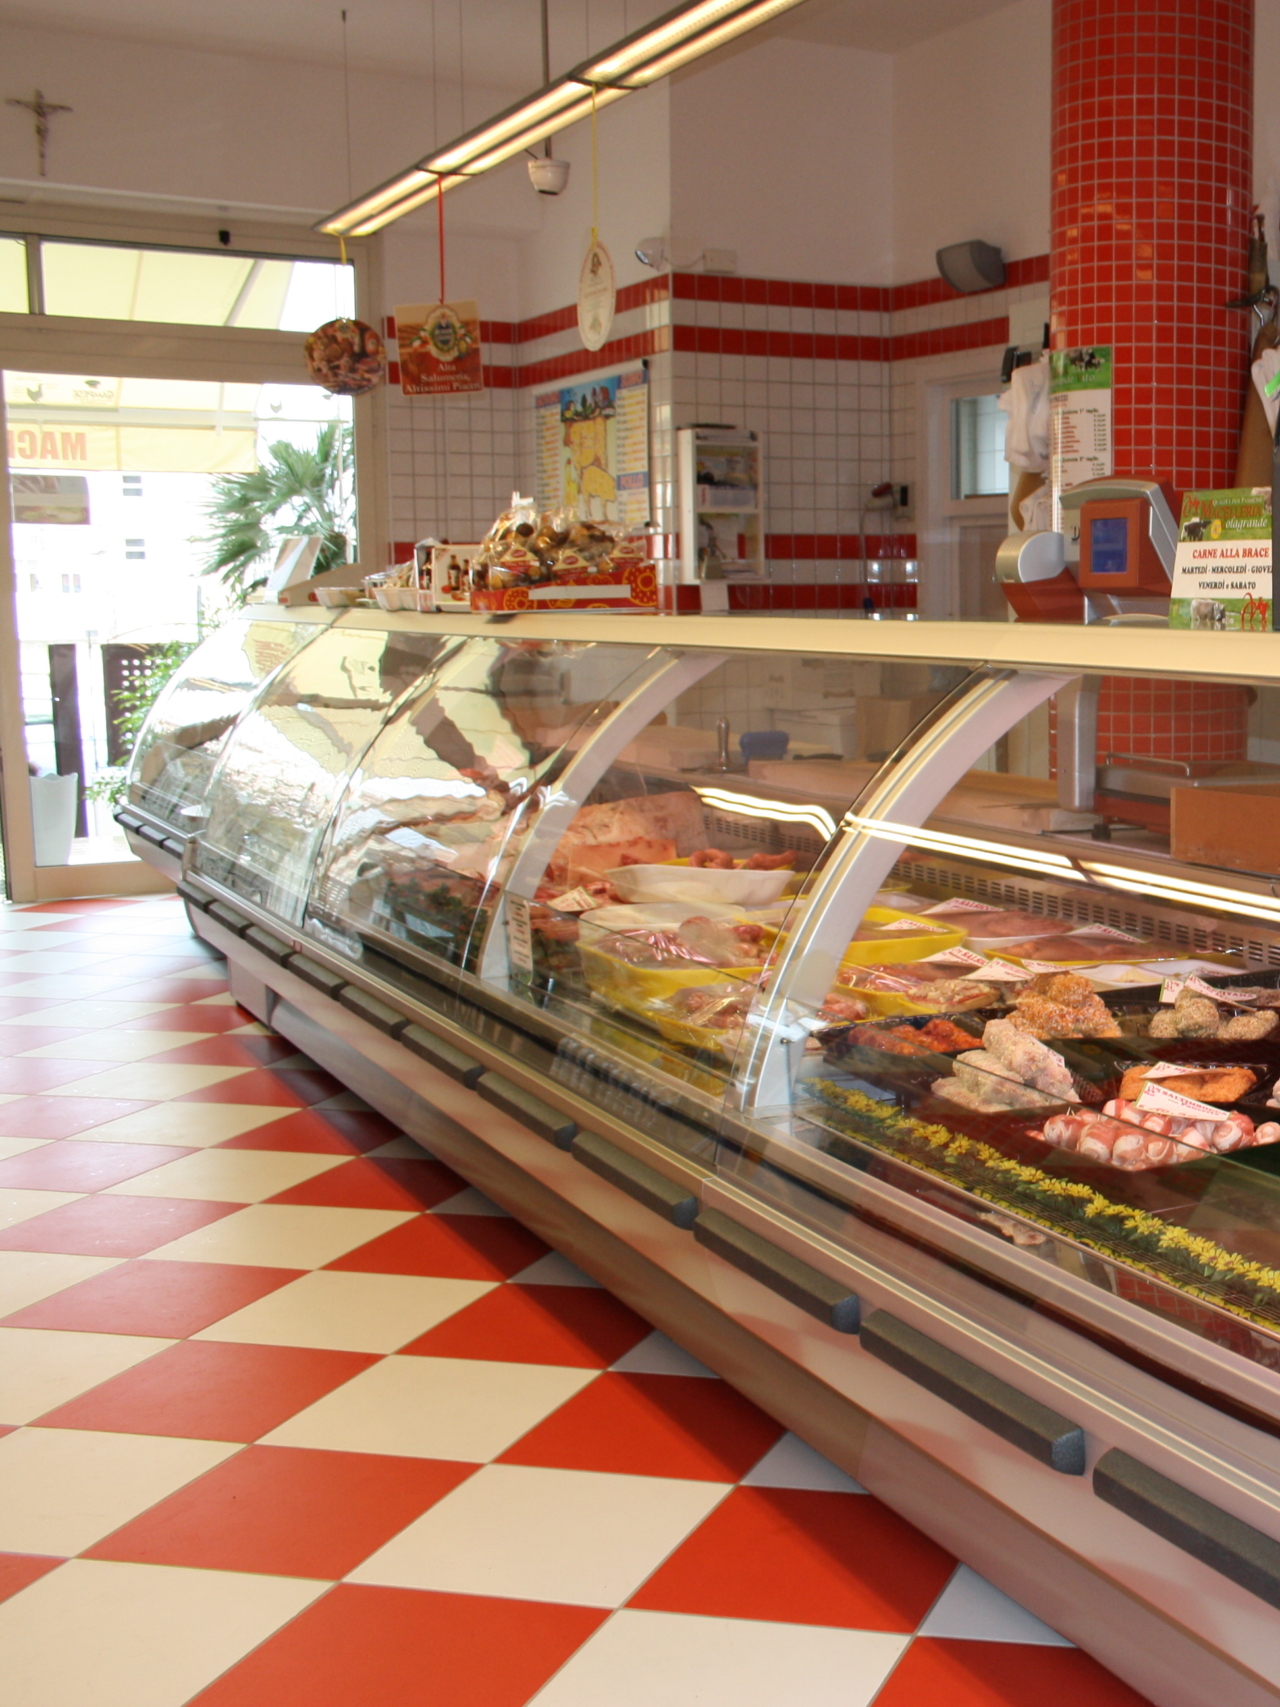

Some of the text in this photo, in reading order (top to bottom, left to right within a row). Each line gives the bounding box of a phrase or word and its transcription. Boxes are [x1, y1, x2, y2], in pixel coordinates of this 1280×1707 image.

[1201, 499, 1263, 519] MACELLERIA
[1192, 547, 1269, 559] CARNE ALLA BRACE
[1230, 581, 1256, 590] SABATO
